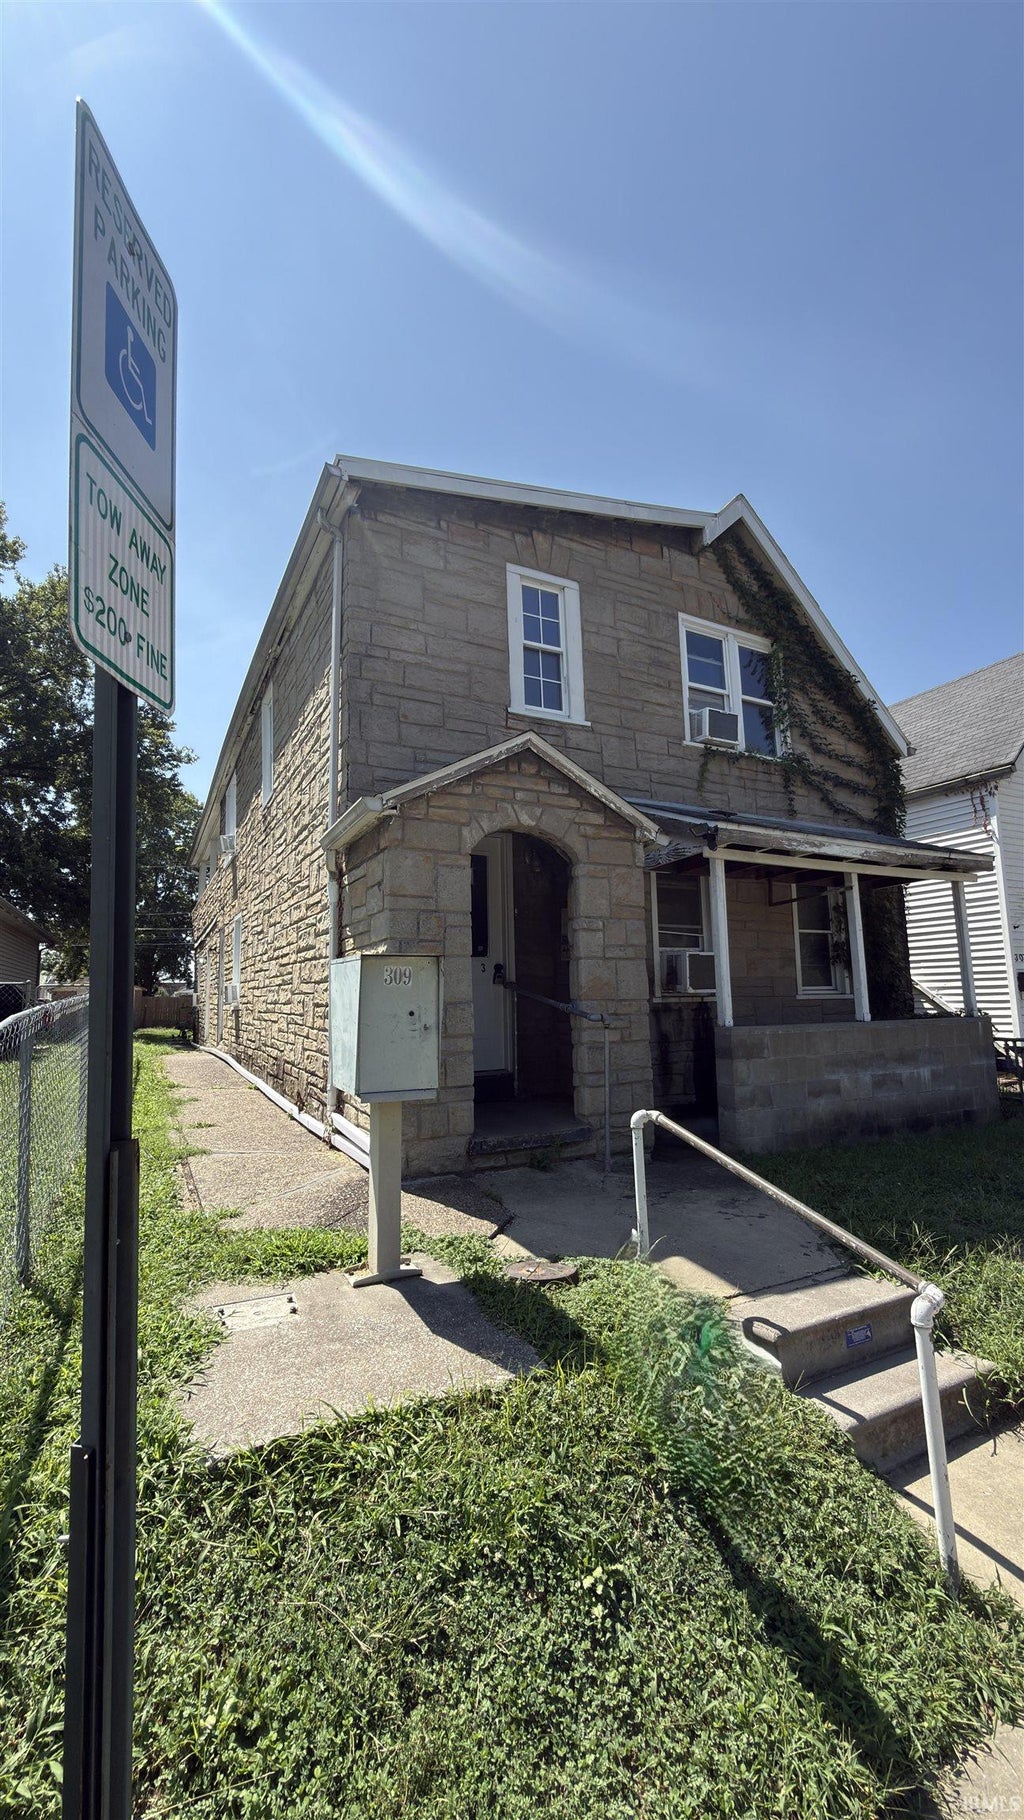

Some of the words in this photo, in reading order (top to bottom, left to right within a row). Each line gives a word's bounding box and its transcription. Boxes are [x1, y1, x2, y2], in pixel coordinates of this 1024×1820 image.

[88, 141, 172, 329] RESERVED
[94, 204, 166, 363] PARKING
[86, 472, 122, 537] TOW
[129, 529, 166, 585] AWAY
[84, 586, 127, 646] $200
[136, 636, 167, 681] FINE
[108, 553, 149, 618] ZONE
[384, 966, 412, 986] 309
